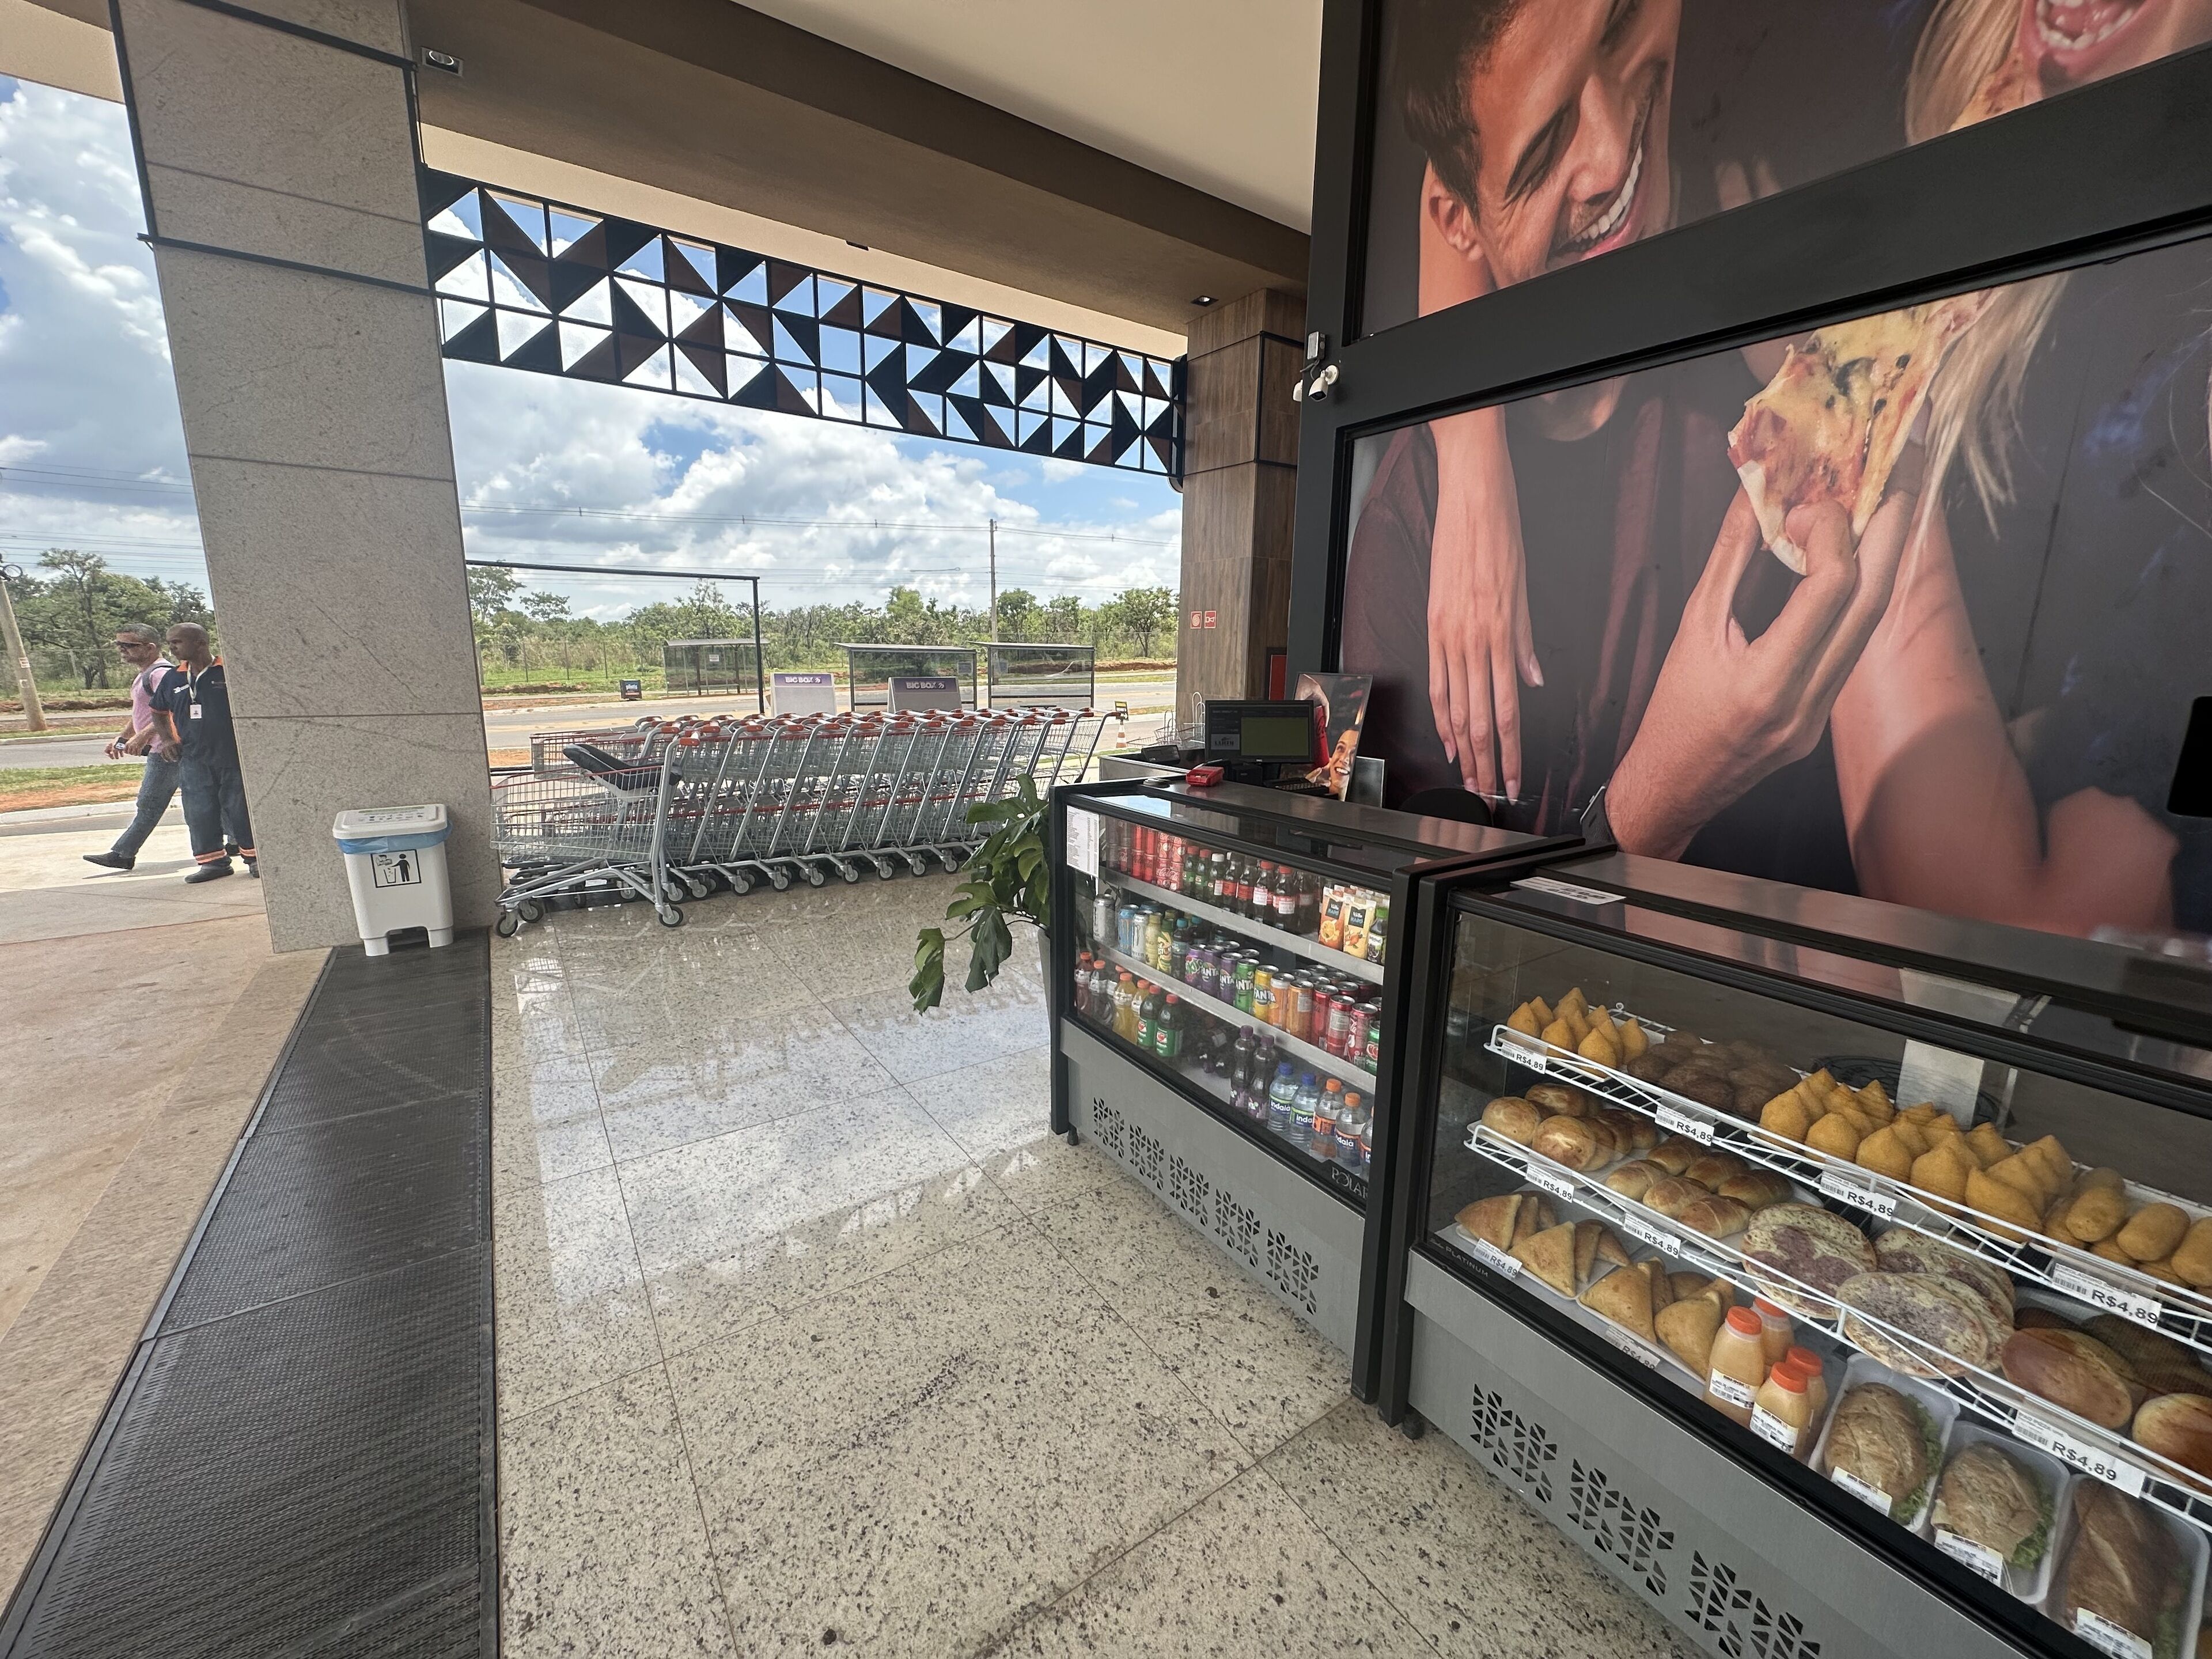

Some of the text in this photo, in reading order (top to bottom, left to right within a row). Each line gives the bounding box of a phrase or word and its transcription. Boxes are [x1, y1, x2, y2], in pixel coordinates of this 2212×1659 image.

[1235, 979, 1254, 990] ANTA
[1297, 1114, 1312, 1123] inda
[1336, 1135, 1354, 1147] daiá
[1677, 1121, 1712, 1142] R$4,89
[1847, 1191, 1893, 1217] R$4,89
[1446, 1246, 1488, 1277] PLATINUM
[2092, 1289, 2158, 1324] R$4,89
[2052, 1441, 2116, 1480] R$4,89
